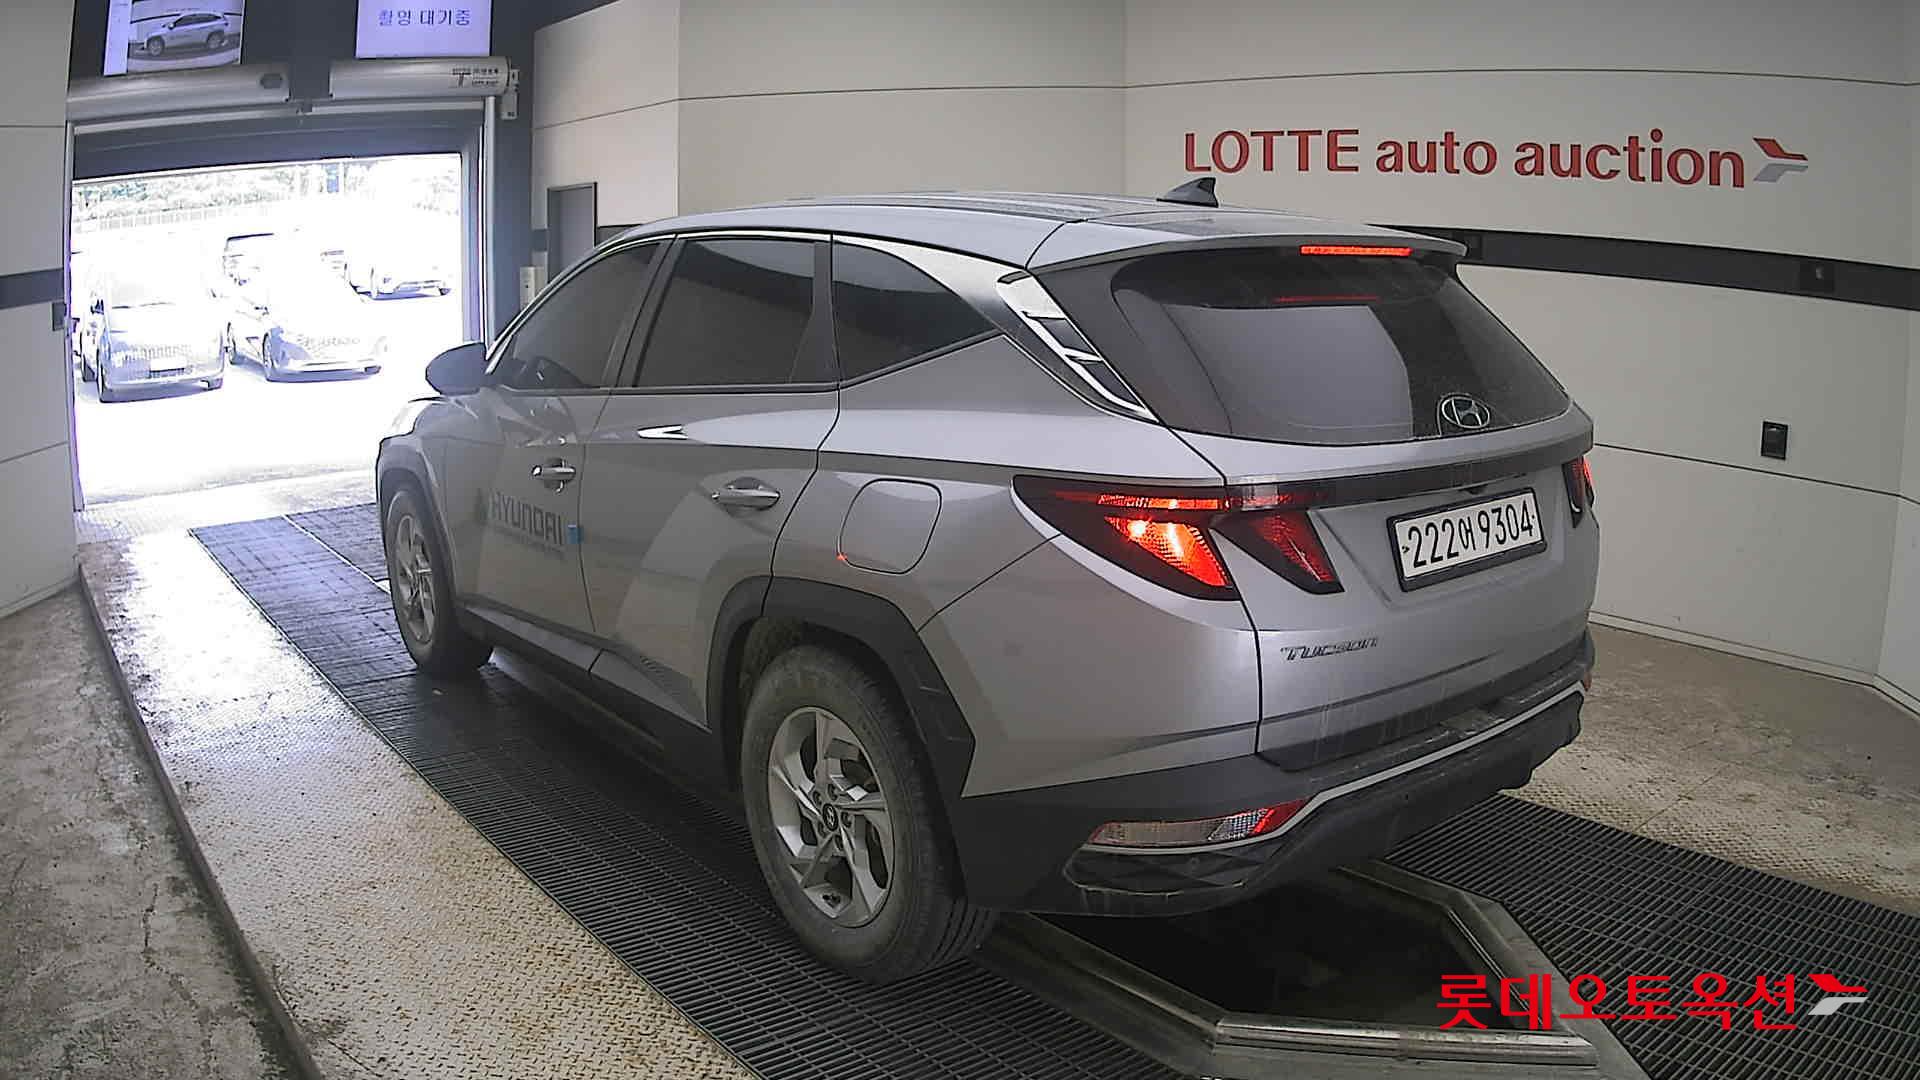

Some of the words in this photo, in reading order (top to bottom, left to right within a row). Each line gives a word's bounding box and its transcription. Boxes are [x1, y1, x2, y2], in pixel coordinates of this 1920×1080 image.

[420, 8, 470, 27] 대기중
[1184, 128, 1360, 173] LOTTE
[1376, 131, 1498, 176] auto
[1513, 127, 1745, 189] auction
